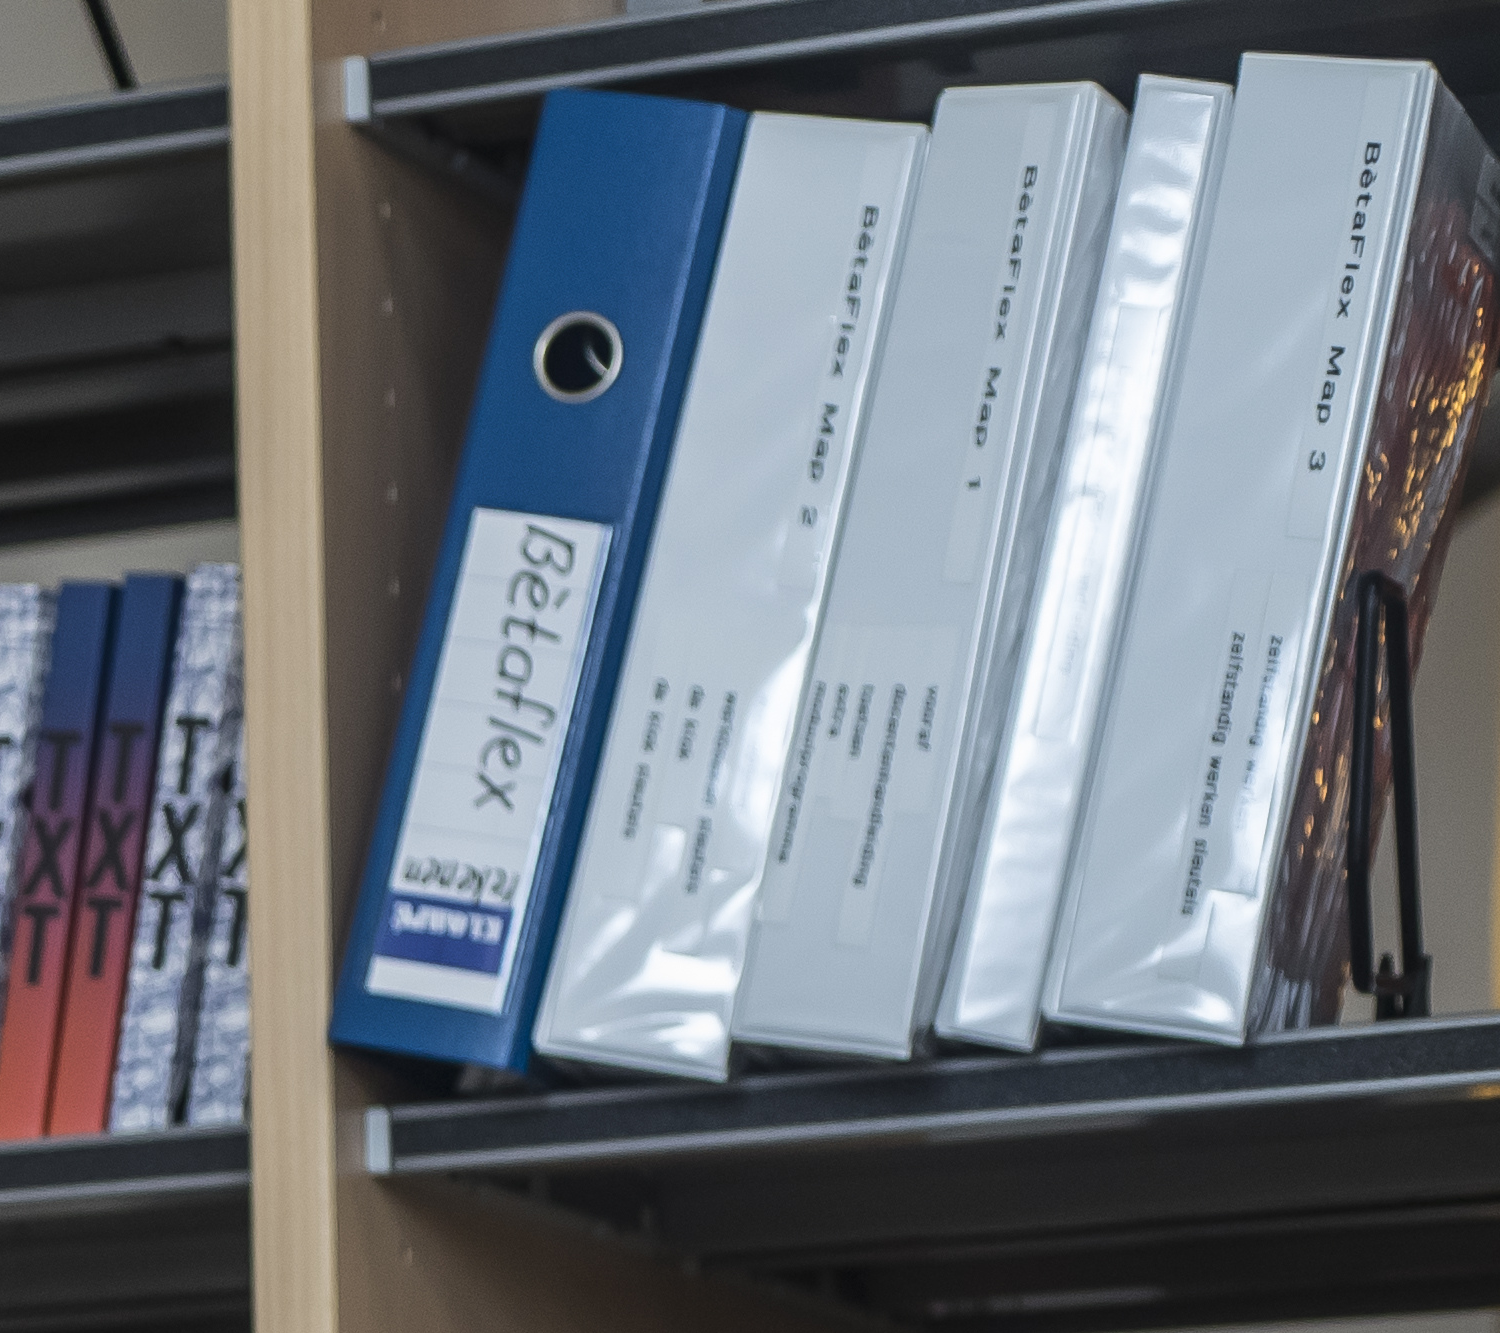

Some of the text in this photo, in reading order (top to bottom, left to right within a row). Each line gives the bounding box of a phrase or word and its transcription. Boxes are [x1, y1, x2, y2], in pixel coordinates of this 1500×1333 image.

[972, 365, 1004, 451] Map
[1314, 343, 1346, 429] Map
[805, 402, 840, 487] Map
[1306, 447, 1329, 475] 3
[797, 507, 820, 530] 2
[21, 731, 82, 985] TXT
[81, 722, 144, 978] TXT
[147, 718, 210, 968] TXT
